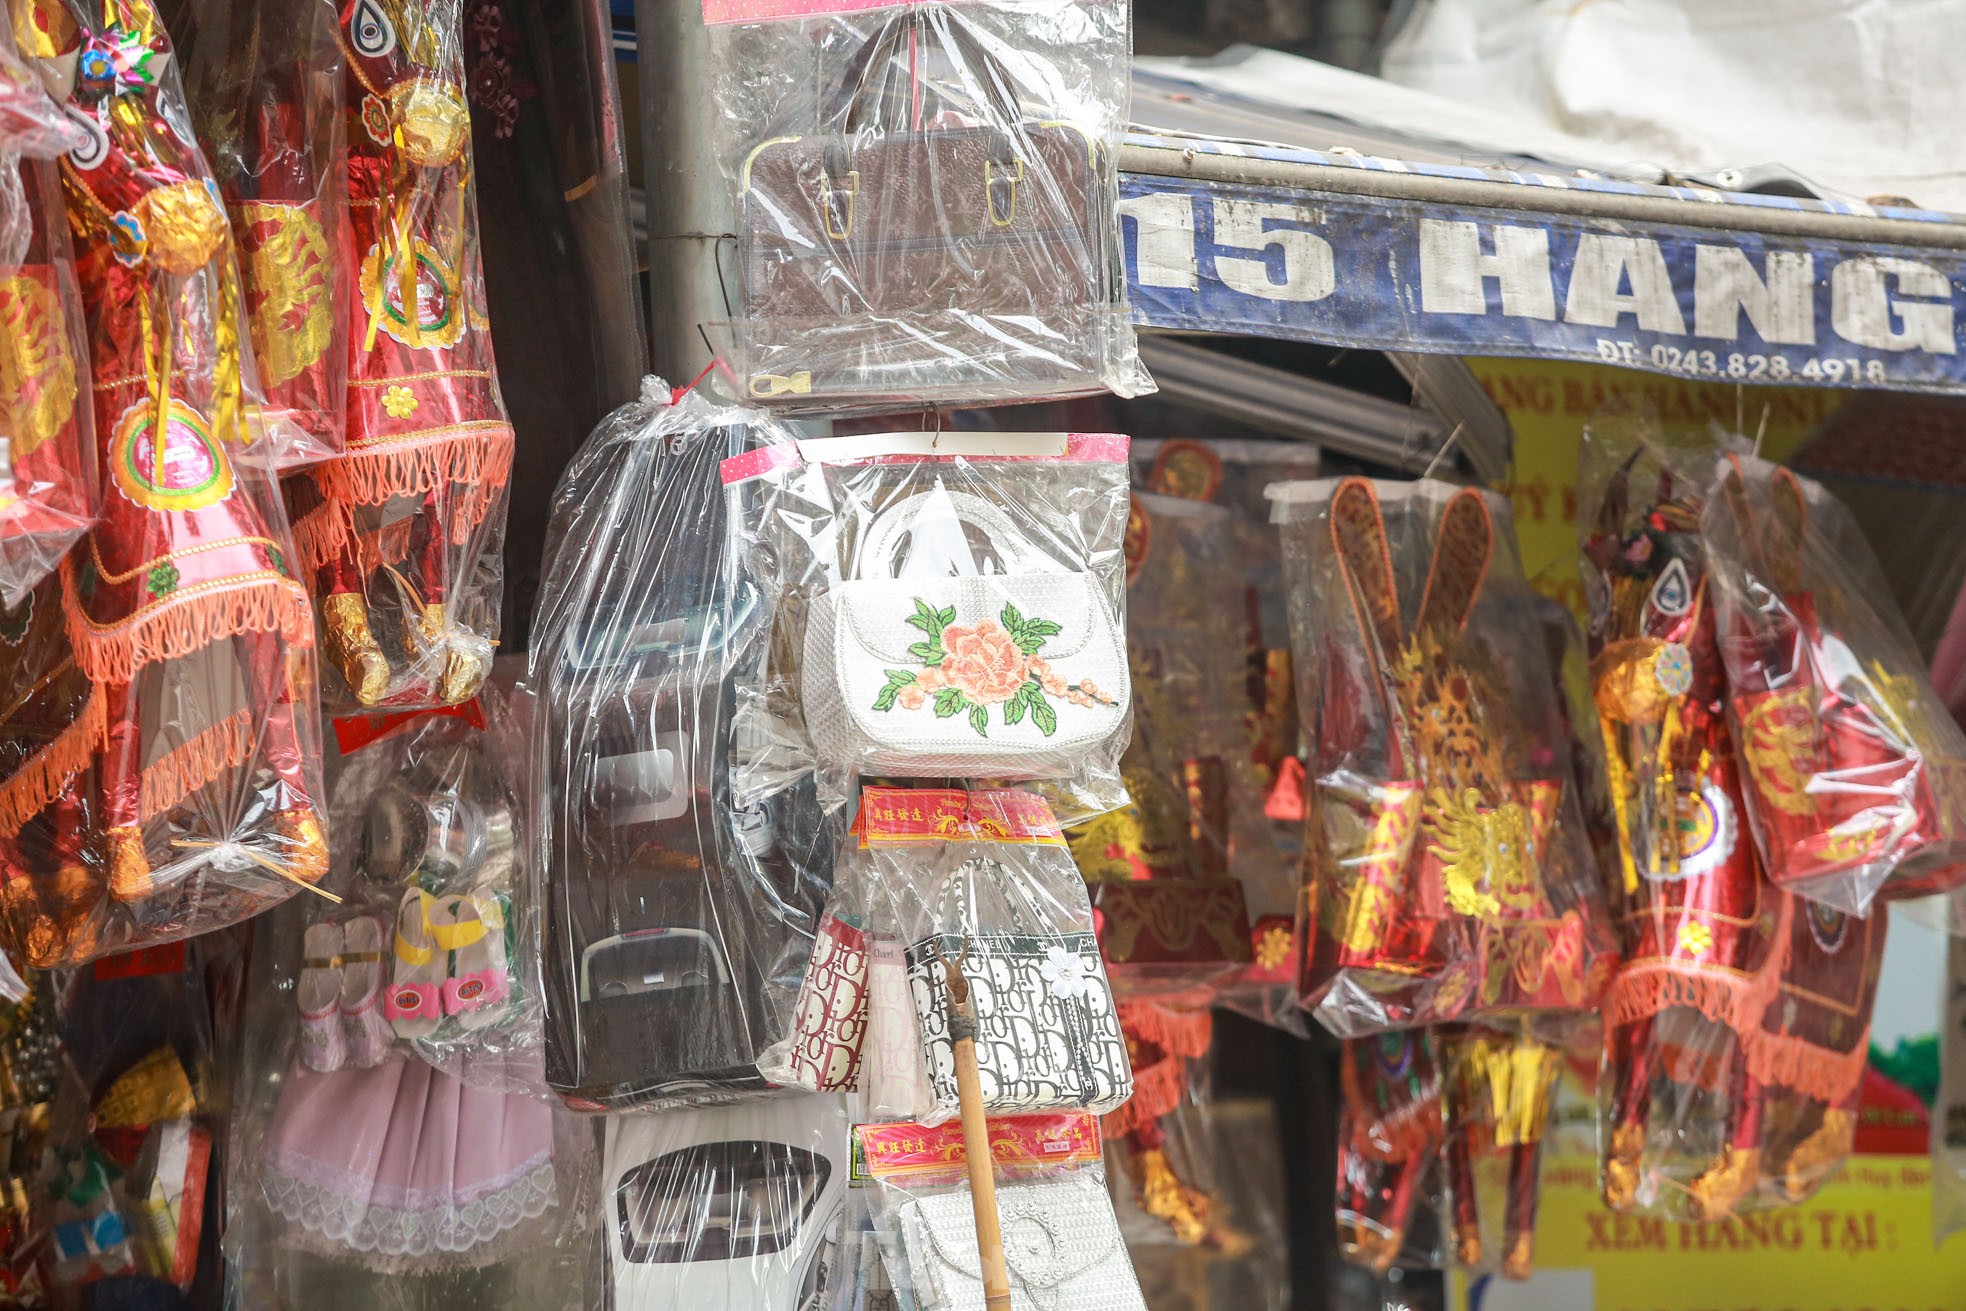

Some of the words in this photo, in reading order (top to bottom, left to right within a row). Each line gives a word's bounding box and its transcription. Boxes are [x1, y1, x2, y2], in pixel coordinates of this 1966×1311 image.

[1118, 192, 1335, 302] 15
[1418, 218, 1956, 355] HANG
[1651, 344, 1886, 384] 0243.828.4918
